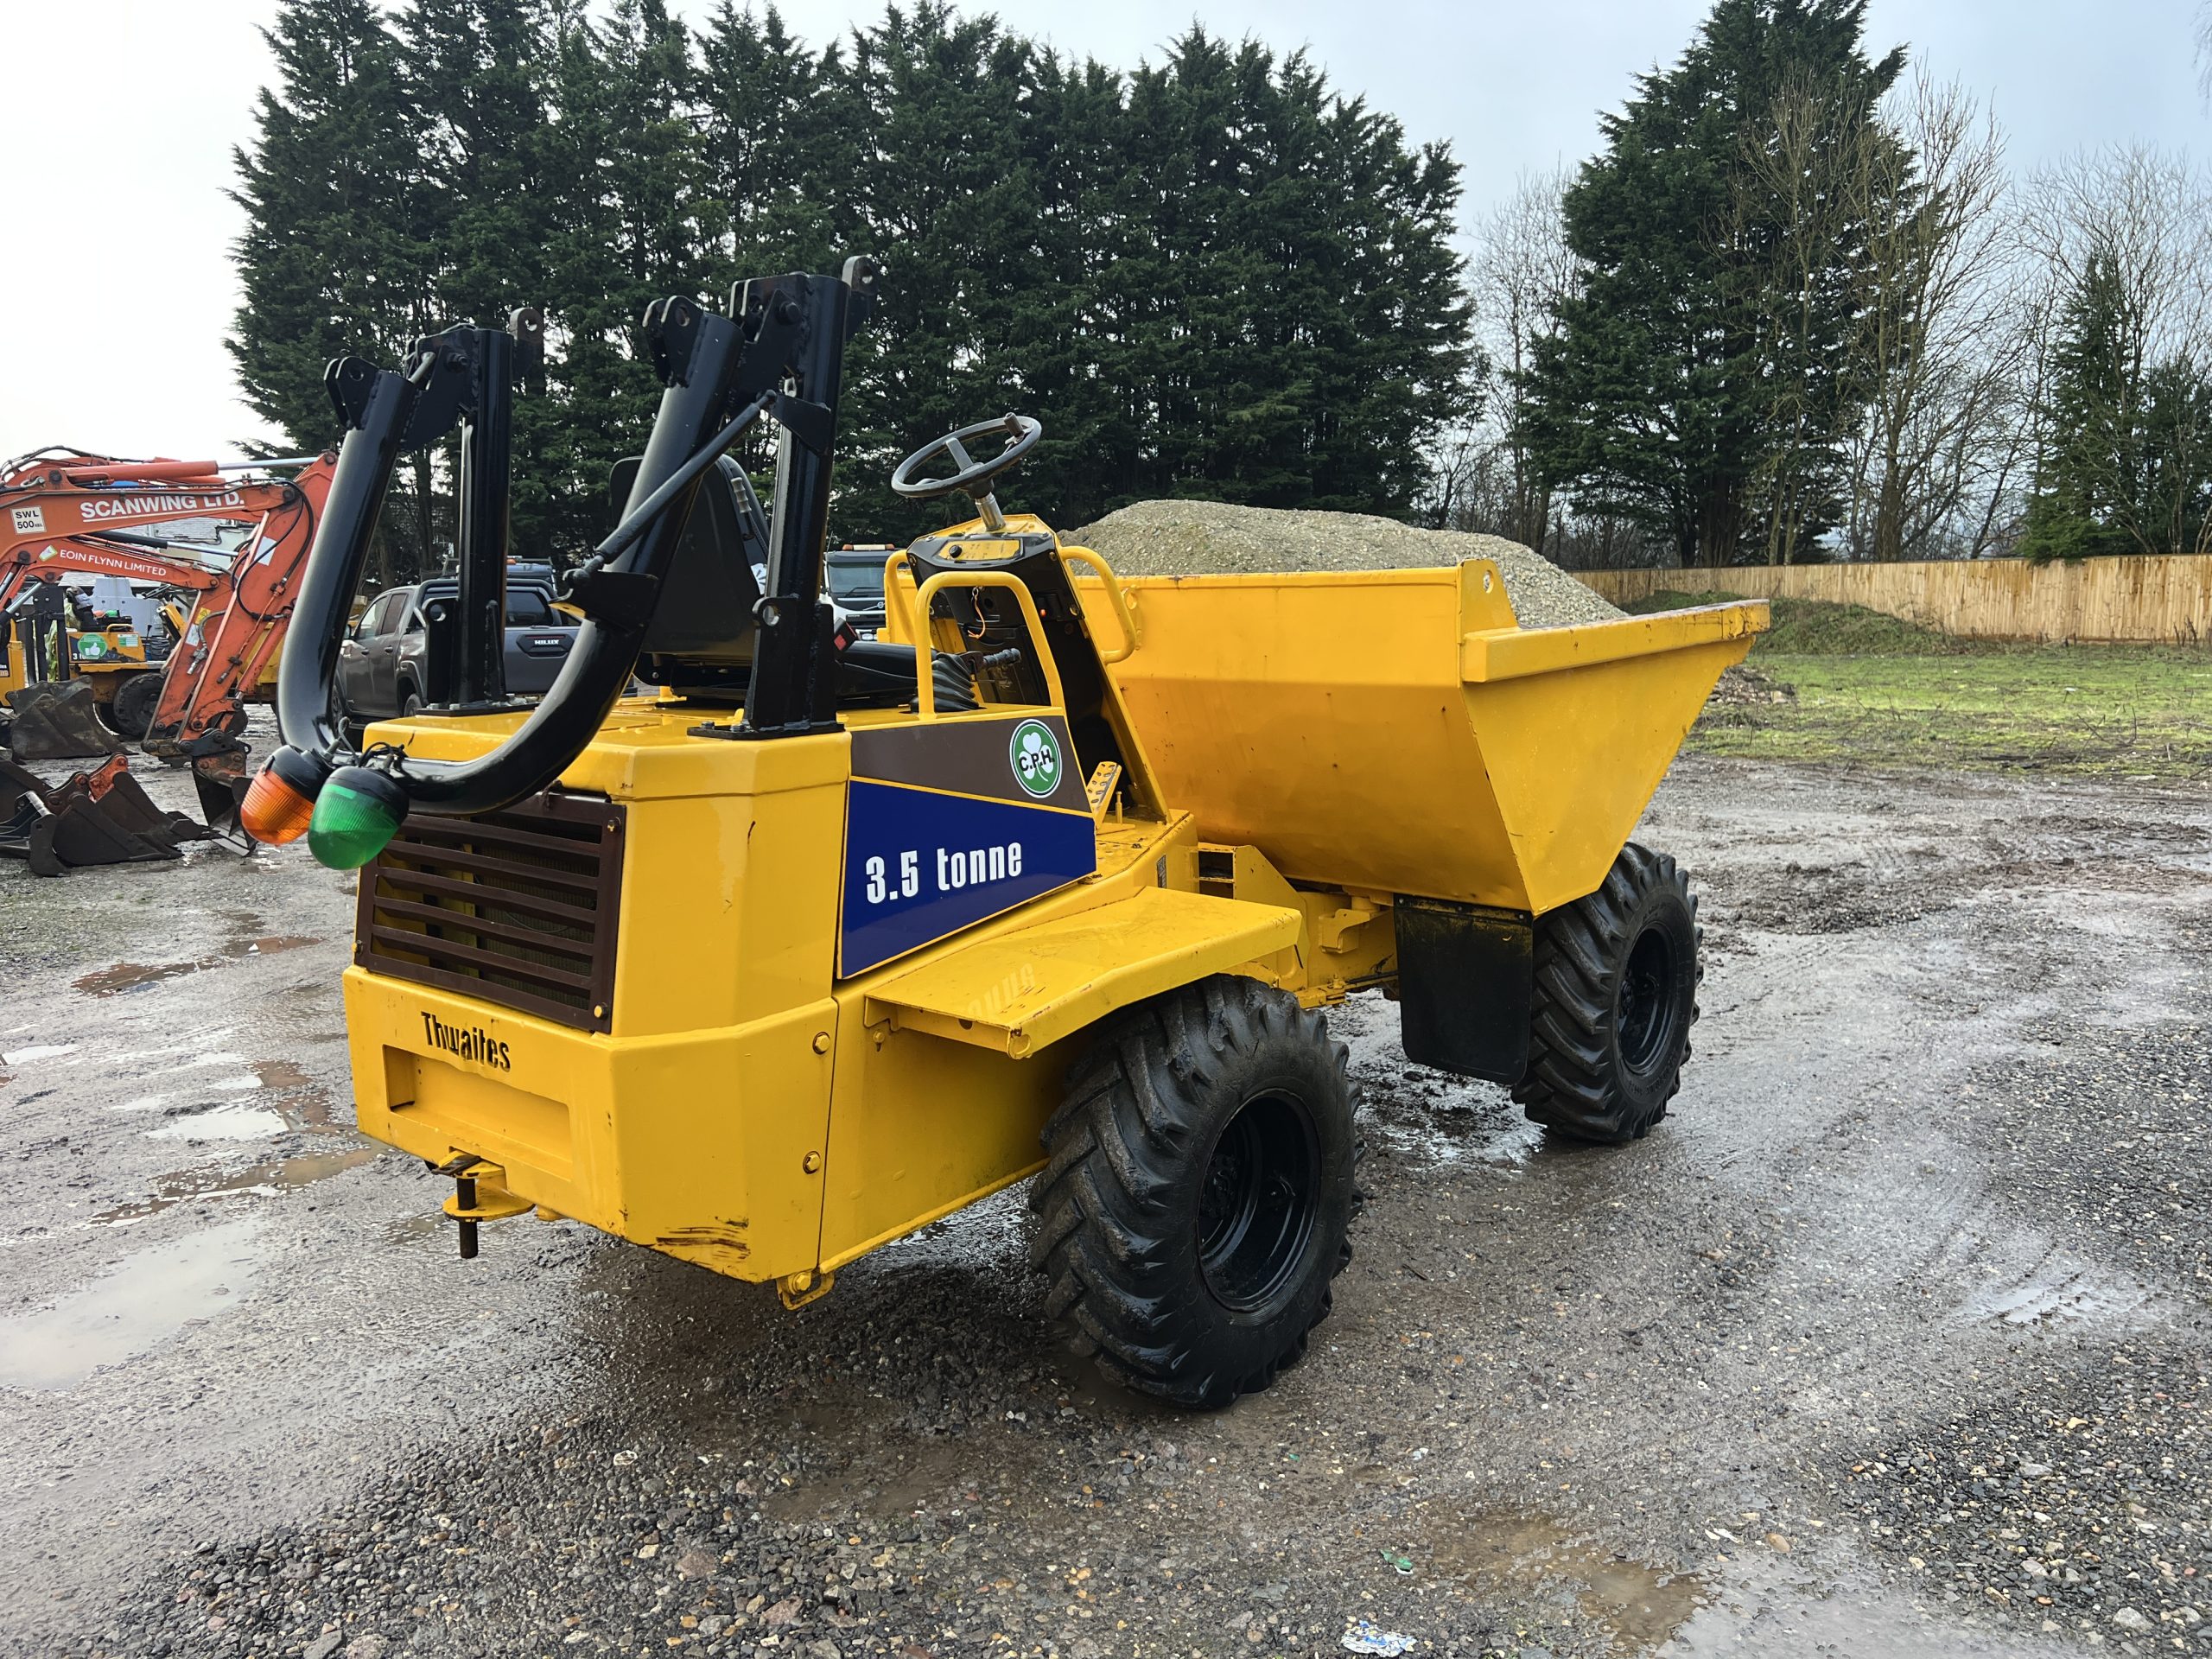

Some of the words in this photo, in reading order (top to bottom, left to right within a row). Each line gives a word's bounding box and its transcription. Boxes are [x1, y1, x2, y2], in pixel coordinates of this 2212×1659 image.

[16, 510, 39, 518] SWL
[80, 495, 198, 518] SCANWING
[17, 520, 35, 529] 500
[60, 550, 86, 562] EOIN
[88, 555, 123, 569] FLYNN
[124, 561, 167, 576] LIMITED
[1019, 748, 1056, 772] C.P.H.
[866, 850, 918, 904] 3.5
[937, 842, 1021, 892] tonne
[420, 1011, 511, 1073] Thwaites
